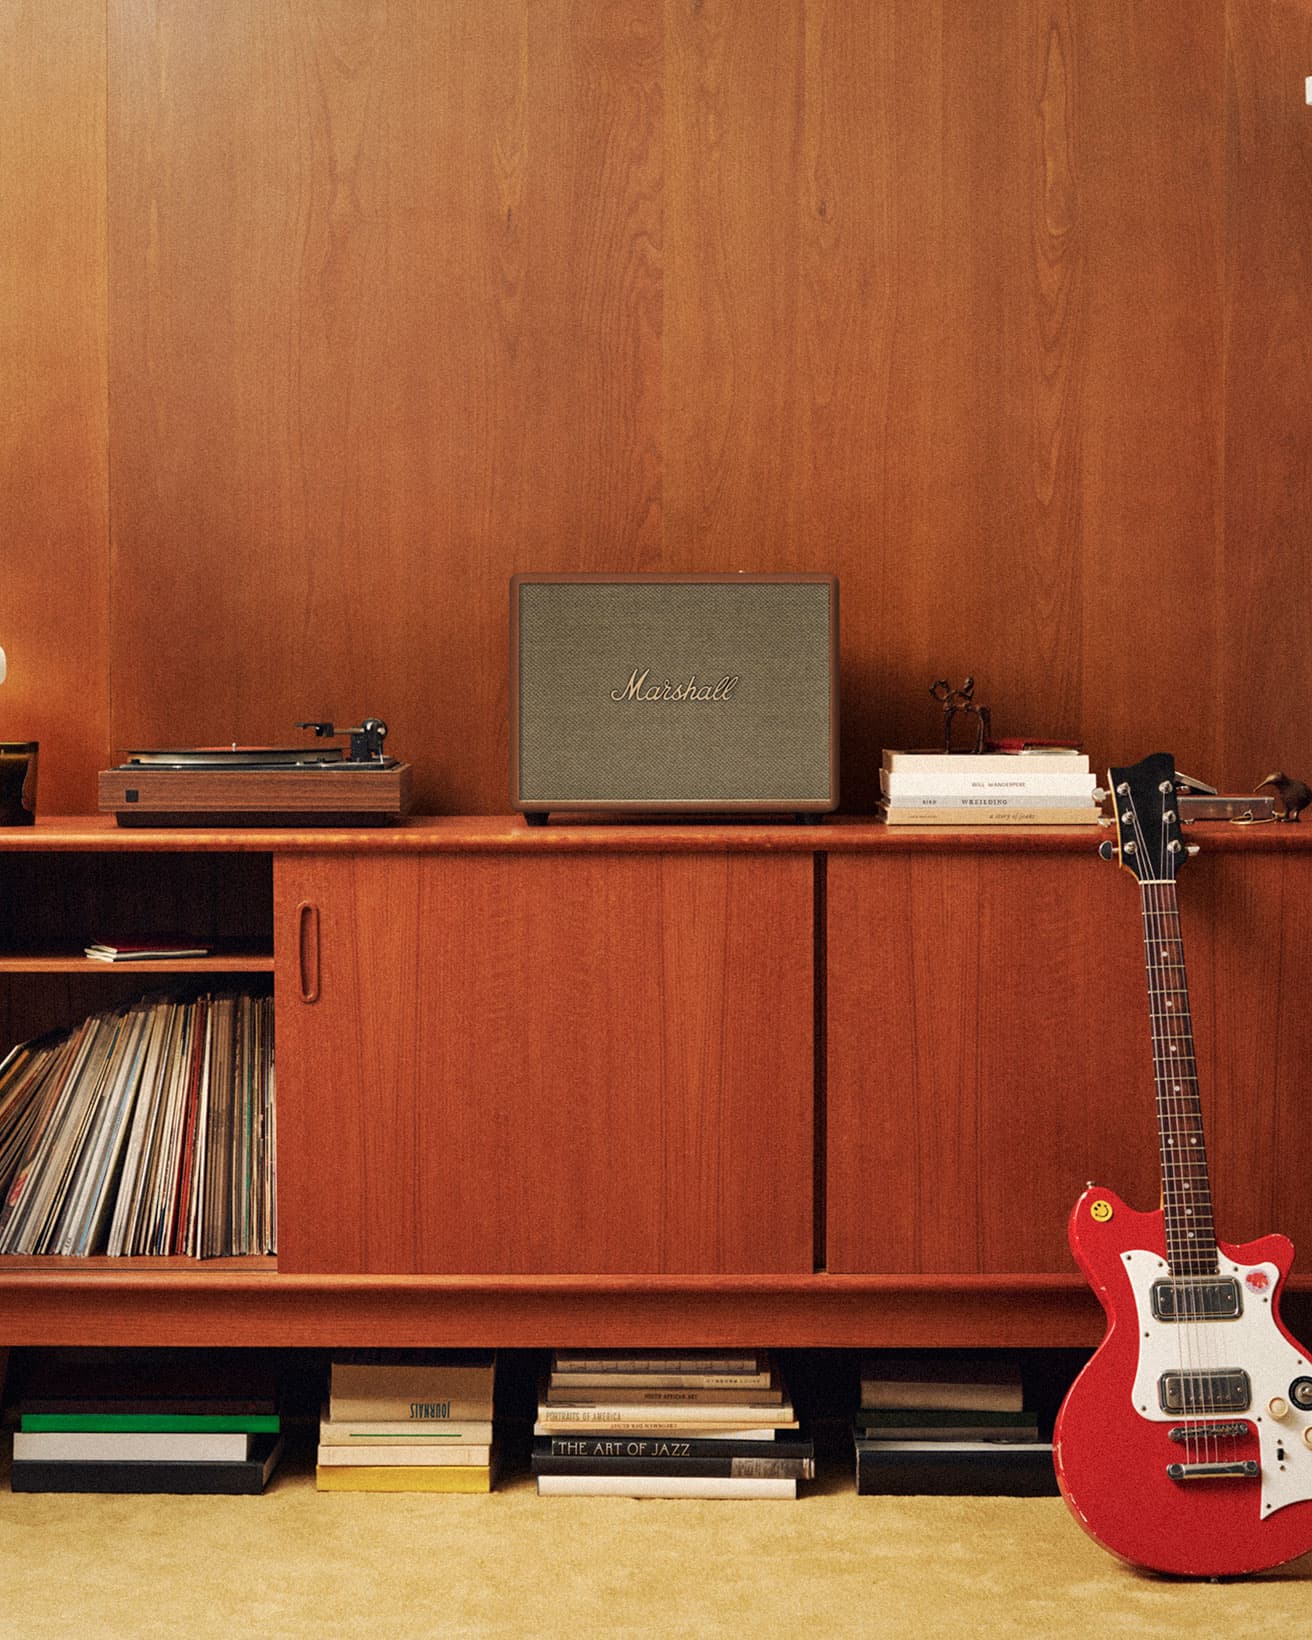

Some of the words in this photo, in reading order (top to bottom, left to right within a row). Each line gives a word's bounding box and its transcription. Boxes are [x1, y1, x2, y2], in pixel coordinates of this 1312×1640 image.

[611, 668, 738, 700] Marshall
[995, 812, 1010, 821] story
[410, 1400, 450, 1419] JOURNALS
[546, 1411, 580, 1422] PORTRAITS
[582, 1411, 590, 1422] OF
[592, 1411, 621, 1422] AMERICA
[558, 1441, 588, 1455] THE
[593, 1442, 623, 1456] ART
[627, 1442, 647, 1456] OF
[651, 1443, 690, 1457] JAZZ
